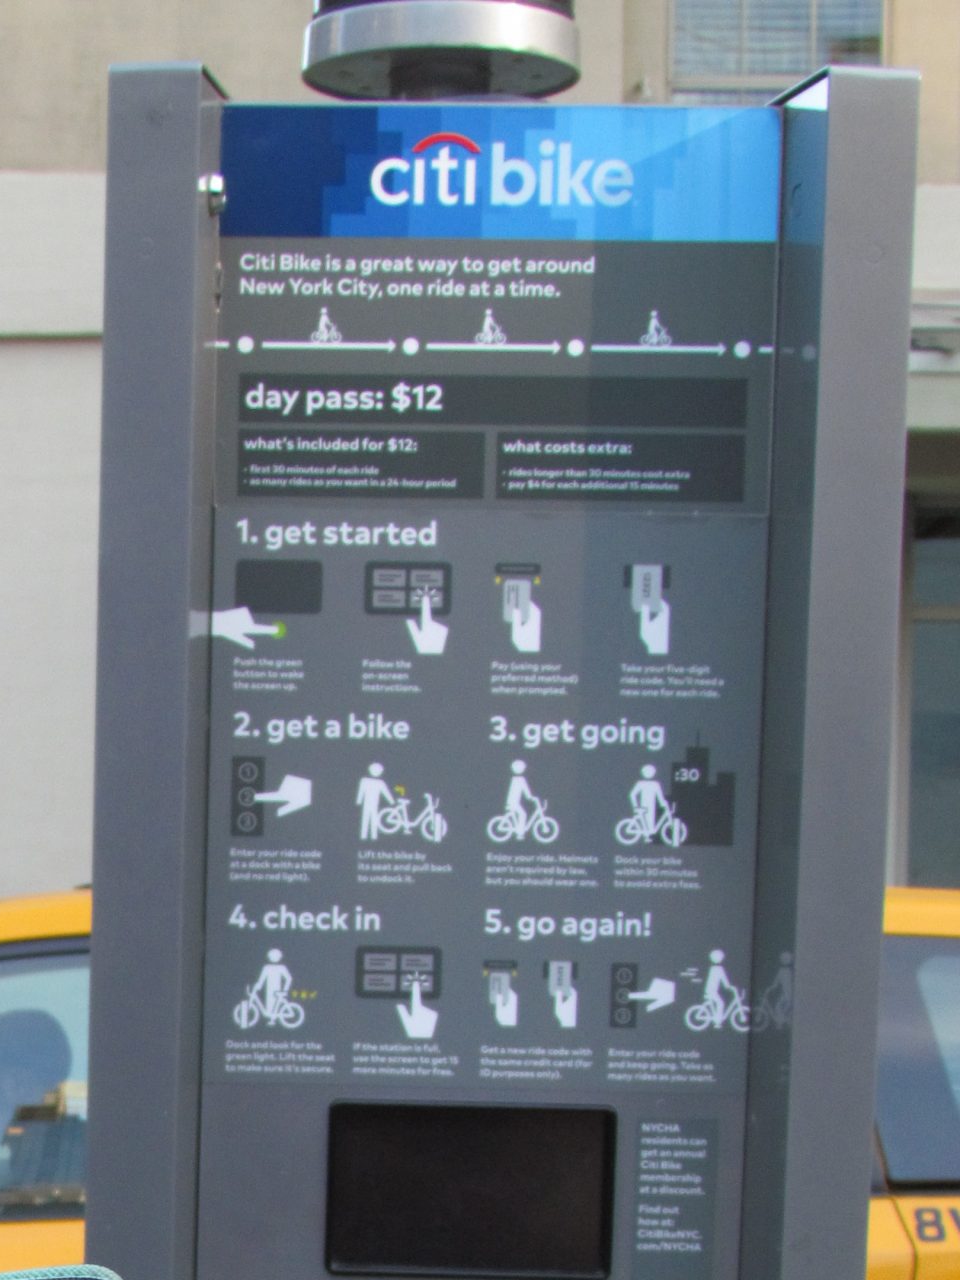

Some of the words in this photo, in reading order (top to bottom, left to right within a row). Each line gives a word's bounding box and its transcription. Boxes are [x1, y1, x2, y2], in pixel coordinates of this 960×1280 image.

[369, 133, 480, 207] citi
[490, 139, 635, 208] bike
[239, 254, 276, 271] Citi
[279, 255, 322, 271] Bike
[326, 255, 342, 272] is
[345, 260, 357, 273] a
[360, 257, 413, 276] great
[417, 260, 458, 276] way
[461, 257, 484, 273] to
[487, 258, 521, 276] get
[525, 256, 596, 274] around
[239, 279, 285, 295] New
[289, 279, 334, 296] York
[337, 279, 384, 300] City,
[387, 283, 423, 297] one
[427, 280, 465, 297] ride
[469, 281, 491, 297] at
[494, 284, 505, 298] a
[509, 280, 561, 298] time.
[244, 385, 300, 415] day
[305, 387, 384, 416] pass:
[390, 383, 443, 414] $12
[243, 437, 294, 451] what's
[296, 437, 359, 452] included
[362, 438, 384, 452] for
[387, 437, 418, 453] $12:
[502, 440, 541, 454] what
[544, 442, 586, 454] costs
[587, 442, 633, 456] extra:
[236, 519, 258, 544] 1.
[265, 520, 317, 550] get
[323, 520, 438, 546] started
[233, 711, 260, 738] 2.
[266, 715, 319, 743] get
[324, 719, 341, 738] a
[348, 713, 410, 740] bike
[489, 715, 516, 741] 3.
[523, 719, 575, 748] get
[580, 717, 666, 751] going
[228, 904, 257, 930] 4.
[262, 904, 349, 931] check
[355, 905, 381, 931] in
[484, 908, 511, 934] 5.
[517, 915, 556, 941] go
[561, 911, 652, 942] again!
